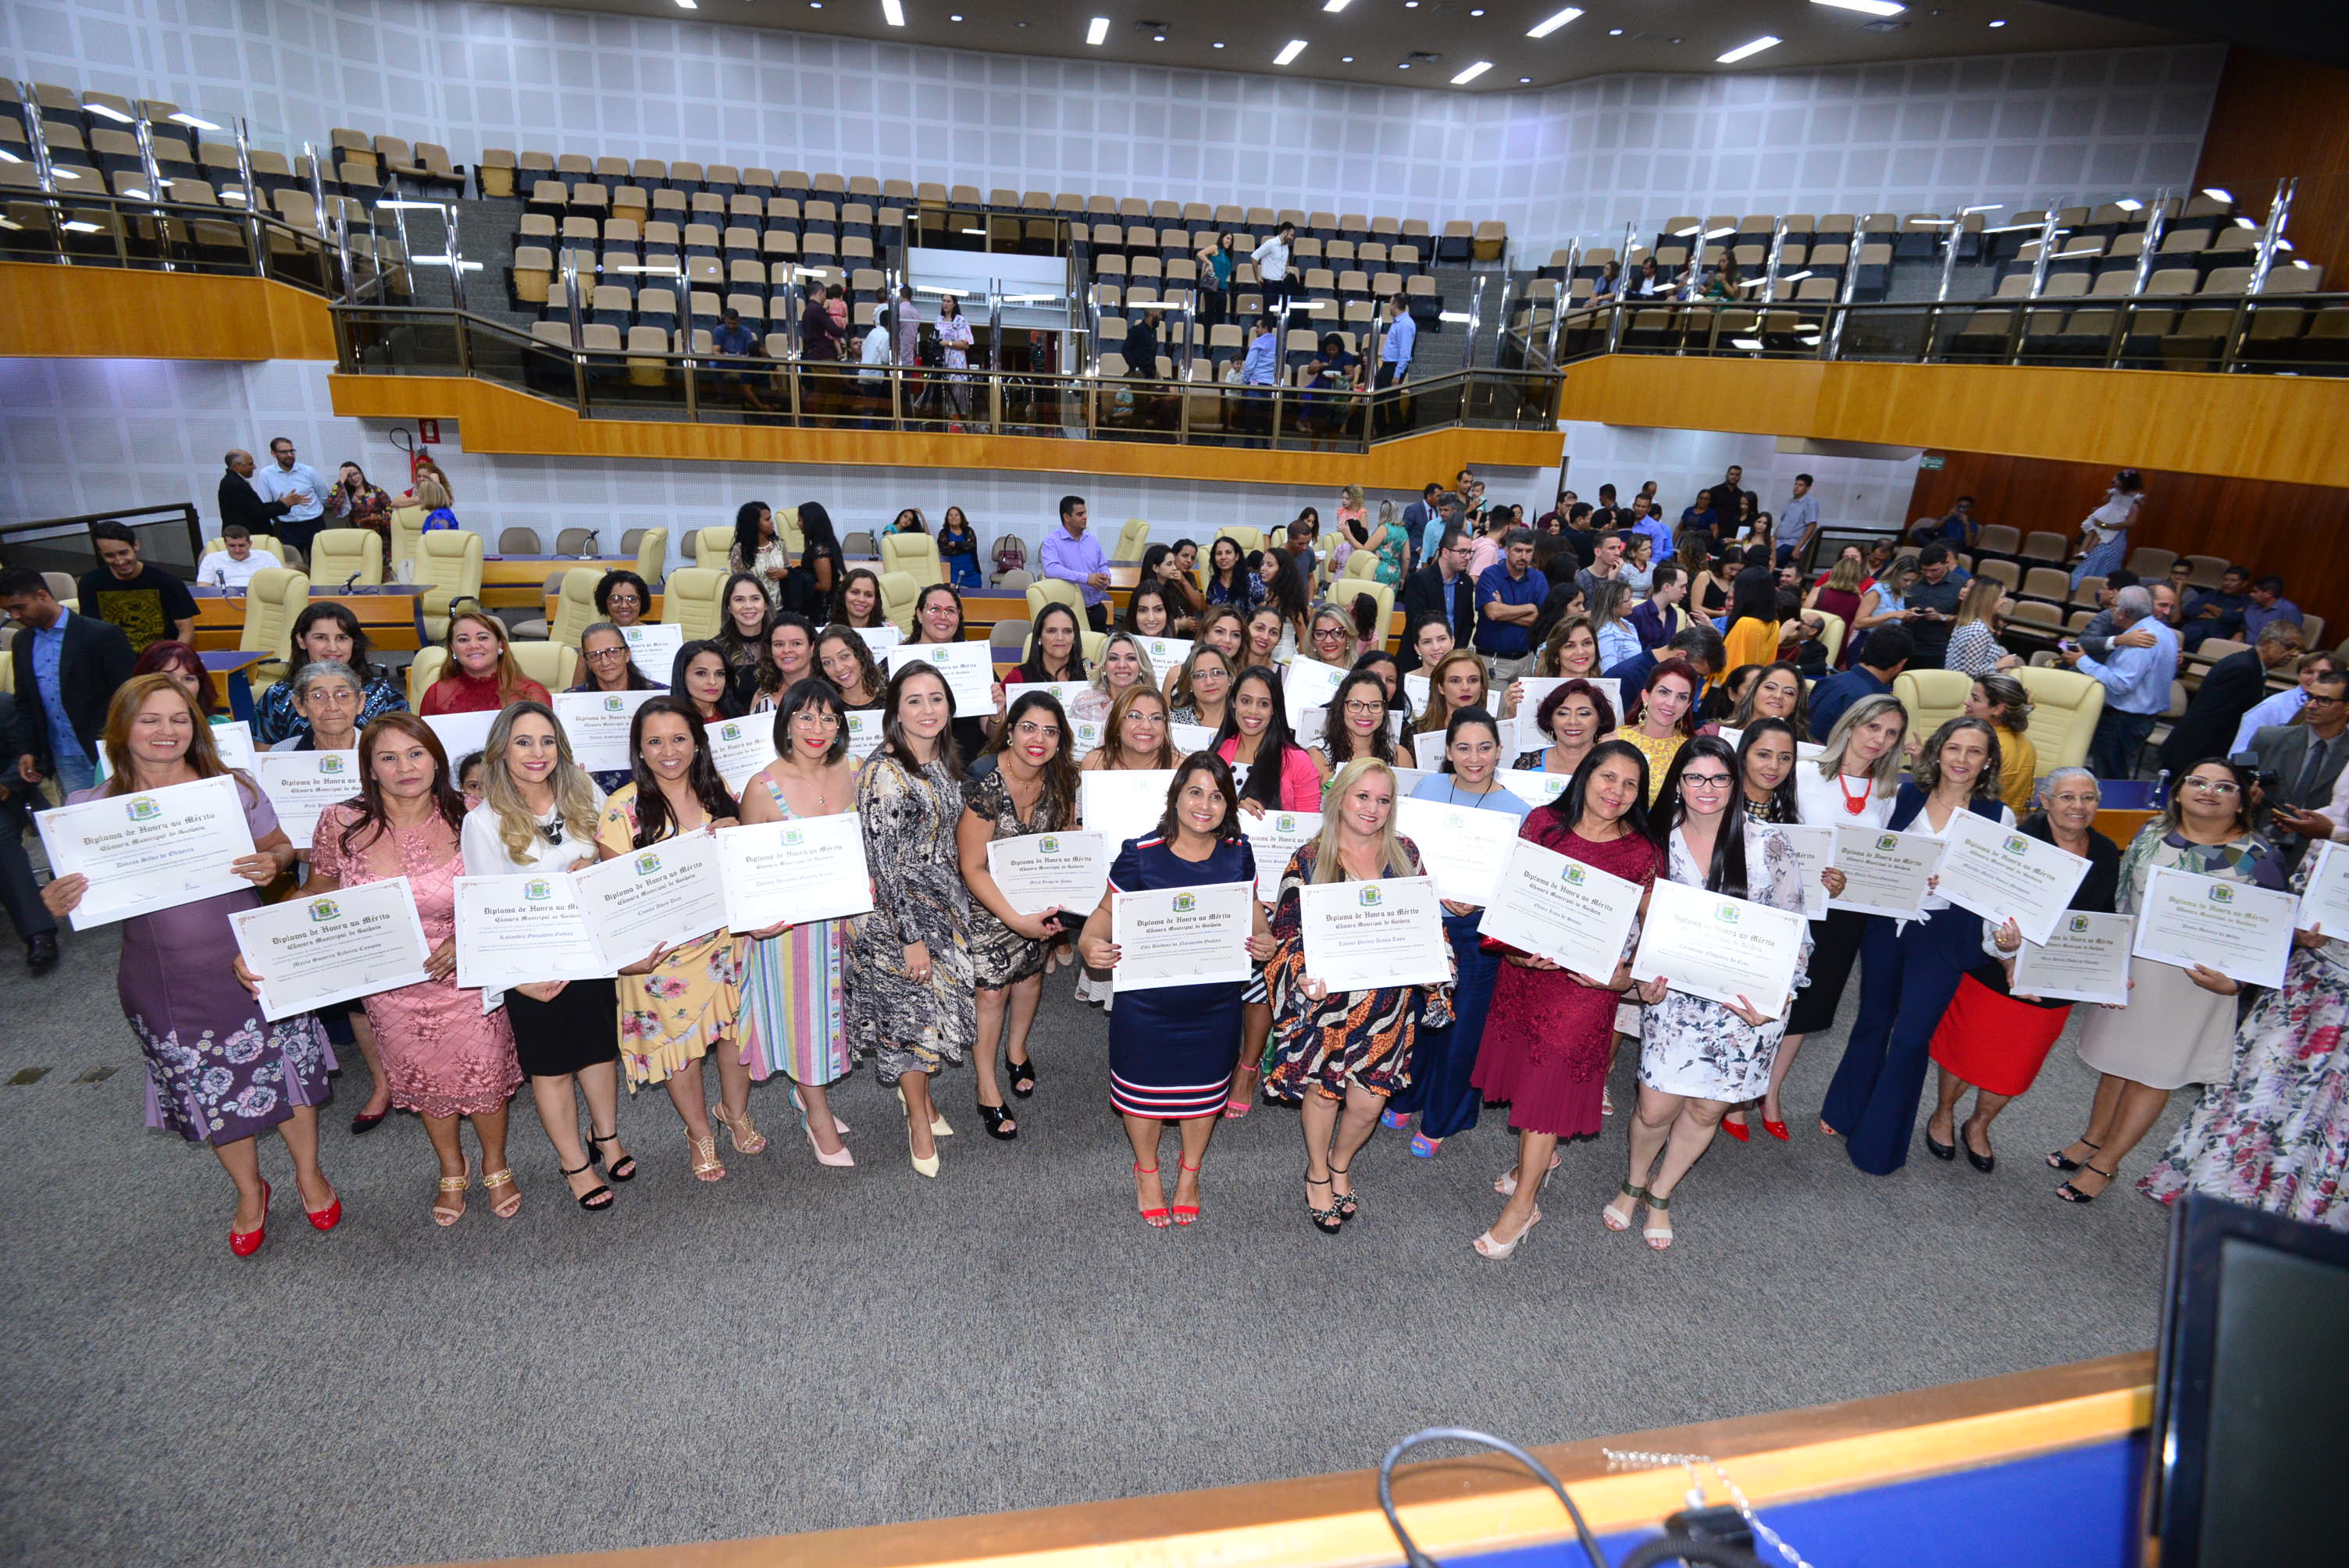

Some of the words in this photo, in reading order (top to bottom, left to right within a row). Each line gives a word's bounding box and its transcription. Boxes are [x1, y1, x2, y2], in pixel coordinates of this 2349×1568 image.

[83, 832, 123, 845] Diploma
[138, 823, 168, 833] Honra
[184, 814, 214, 824] Mérito
[131, 833, 166, 844] Municipal
[1964, 838, 1990, 853] Diploma
[1841, 847, 1864, 856] Diploma
[1873, 852, 1892, 861] Honra
[604, 887, 633, 900] Diploma
[644, 875, 667, 886] Honra
[679, 862, 702, 874] Mérito
[640, 882, 667, 896] Municipal
[1524, 870, 1549, 886] Diploma
[1559, 885, 1579, 898] Honra
[1581, 893, 1589, 902] ao
[1591, 898, 1613, 911] Mérito
[1550, 892, 1574, 904] Municipal
[2168, 896, 2196, 907] Diploma
[272, 932, 307, 944] Diploma
[320, 923, 348, 933] Honra
[362, 914, 390, 924] Mérito
[315, 932, 346, 943] Municipal
[1749, 935, 1774, 946] Mérito
